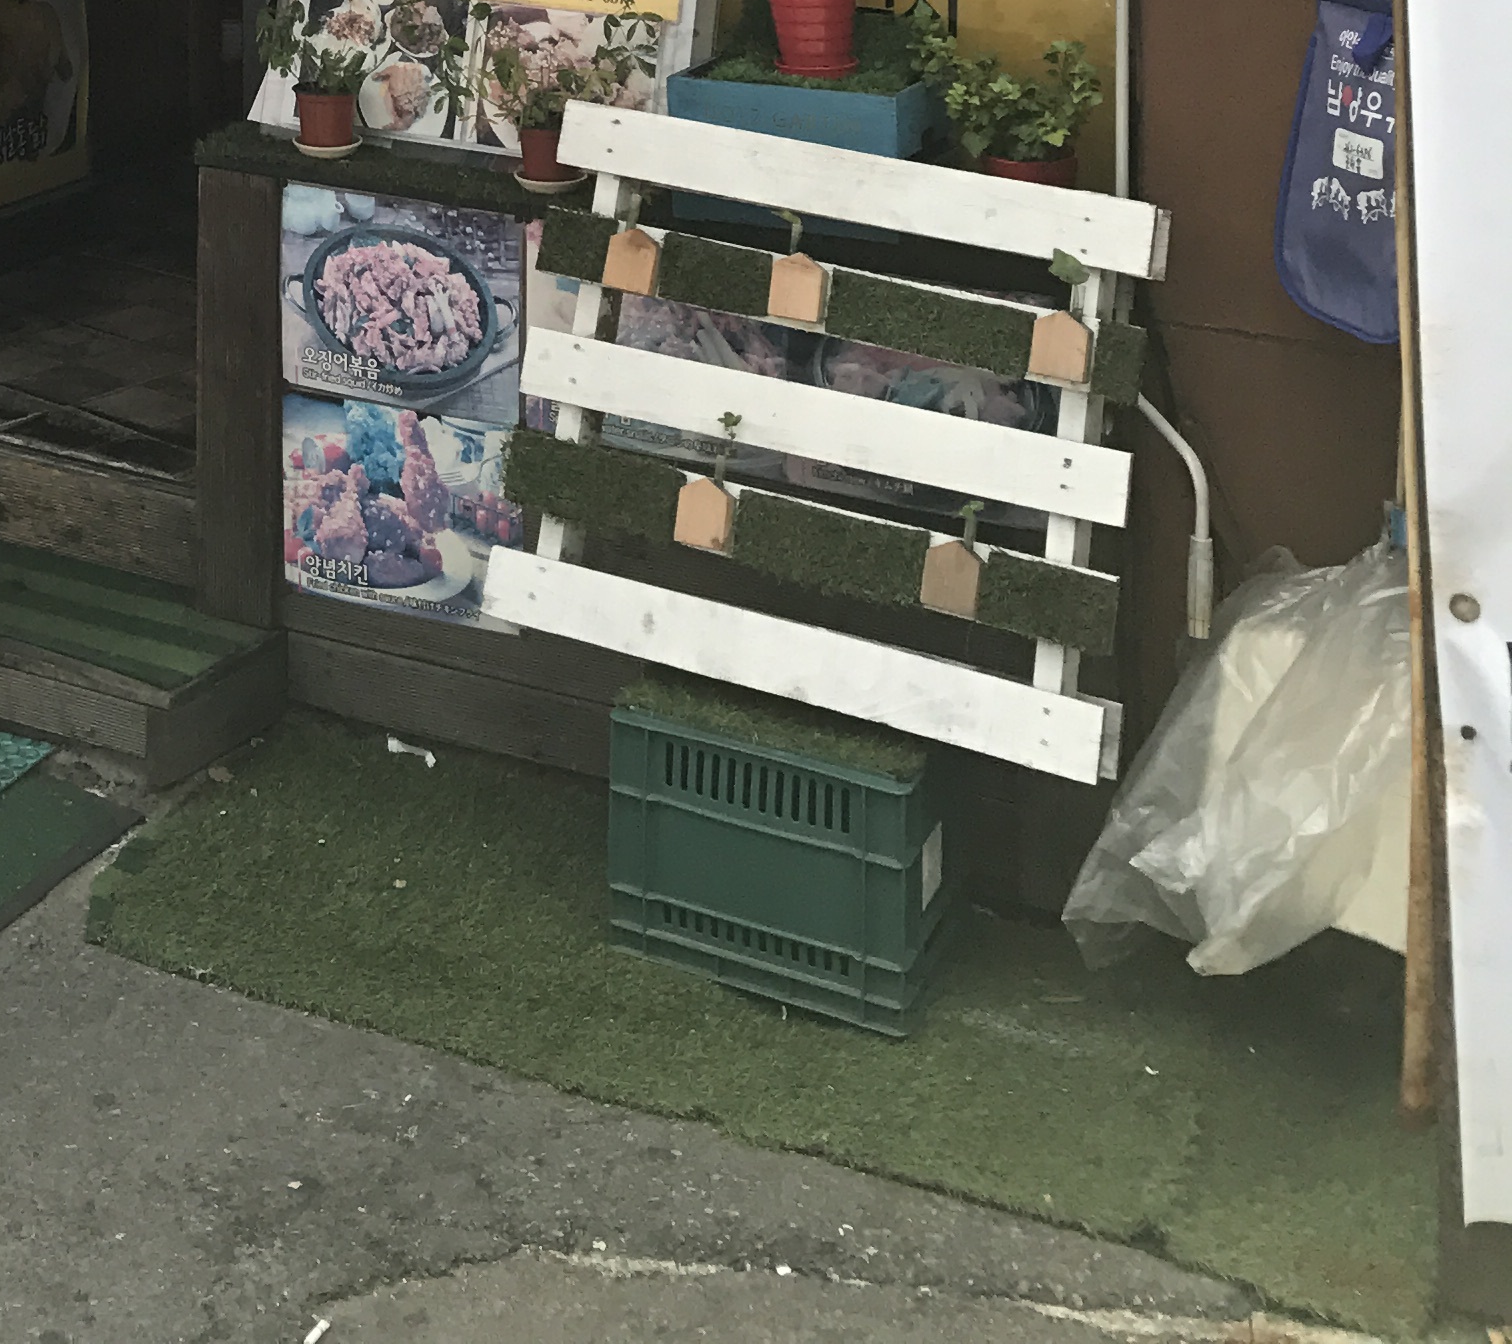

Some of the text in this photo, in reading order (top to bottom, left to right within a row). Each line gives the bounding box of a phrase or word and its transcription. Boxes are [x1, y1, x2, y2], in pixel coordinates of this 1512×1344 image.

[1330, 54, 1355, 78] Enjoy
[303, 347, 381, 380] 오징어볶음
[306, 554, 368, 586] 양념치킨
